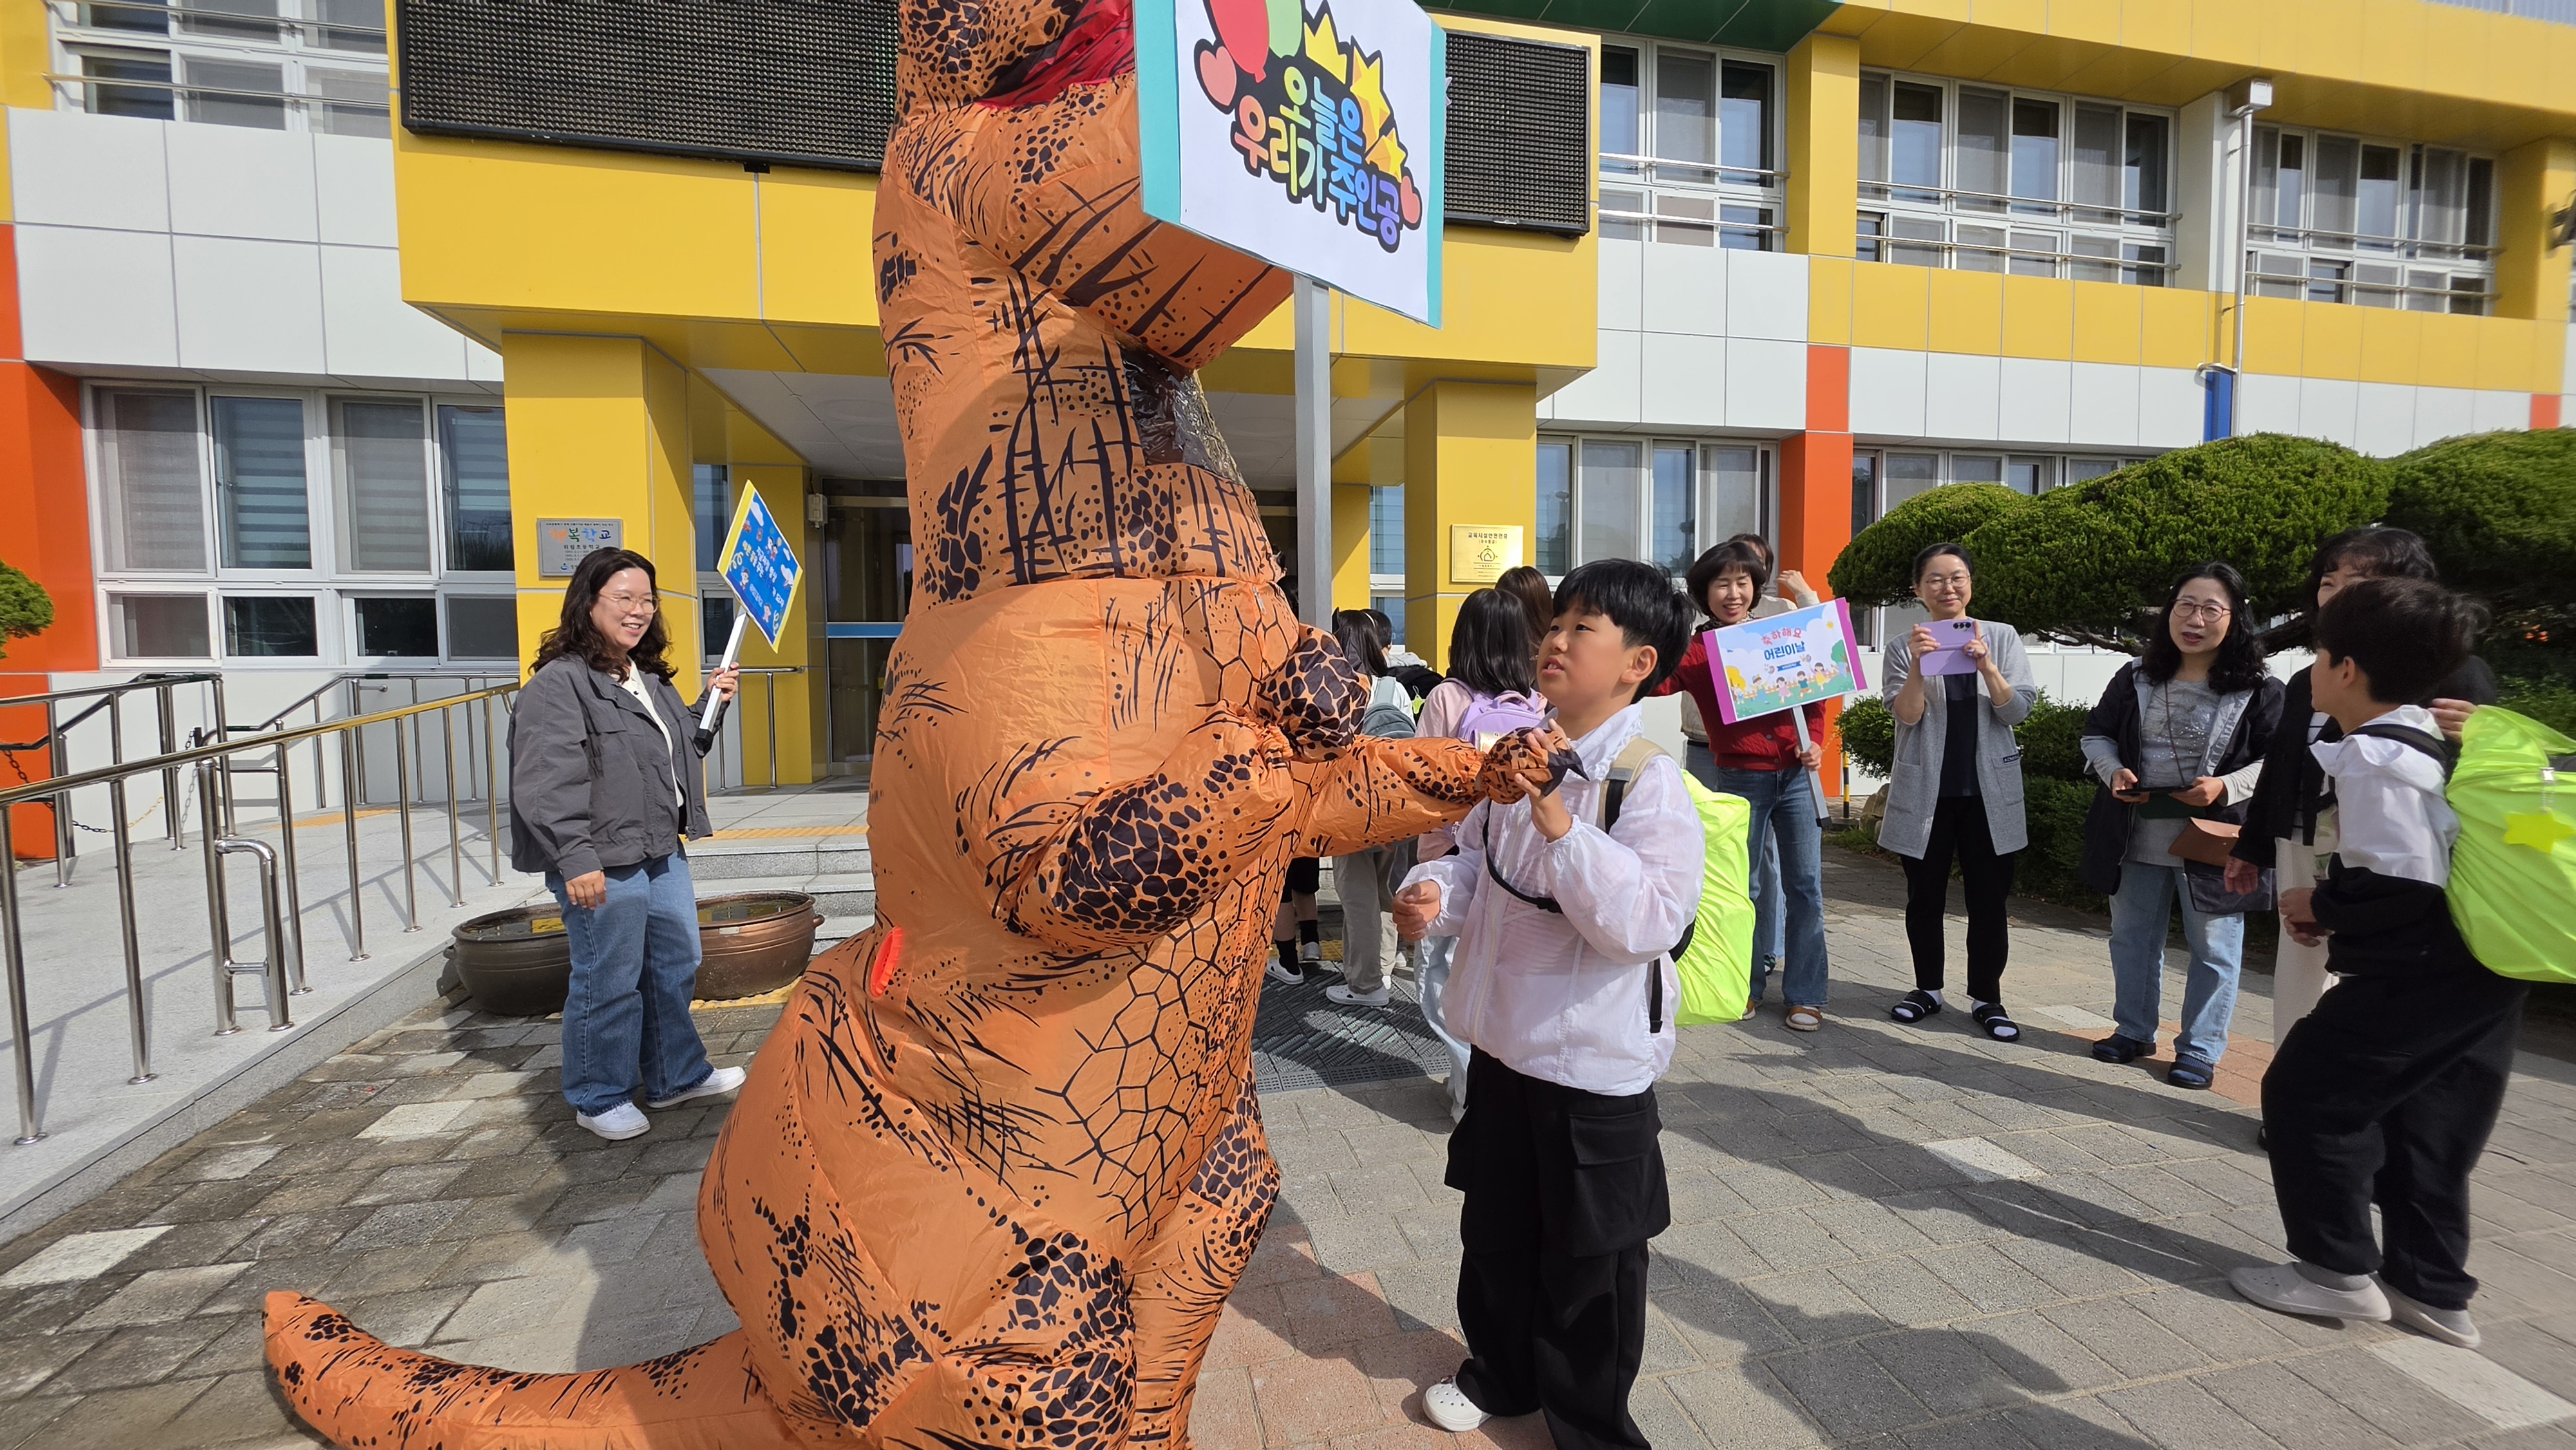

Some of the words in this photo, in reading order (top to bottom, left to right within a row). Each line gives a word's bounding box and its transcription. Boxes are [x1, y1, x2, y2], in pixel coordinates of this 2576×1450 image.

[1280, 66, 1363, 164] 오늘은
[1761, 627, 1802, 645] 축하해요
[1764, 641, 1806, 661] 어린이날
